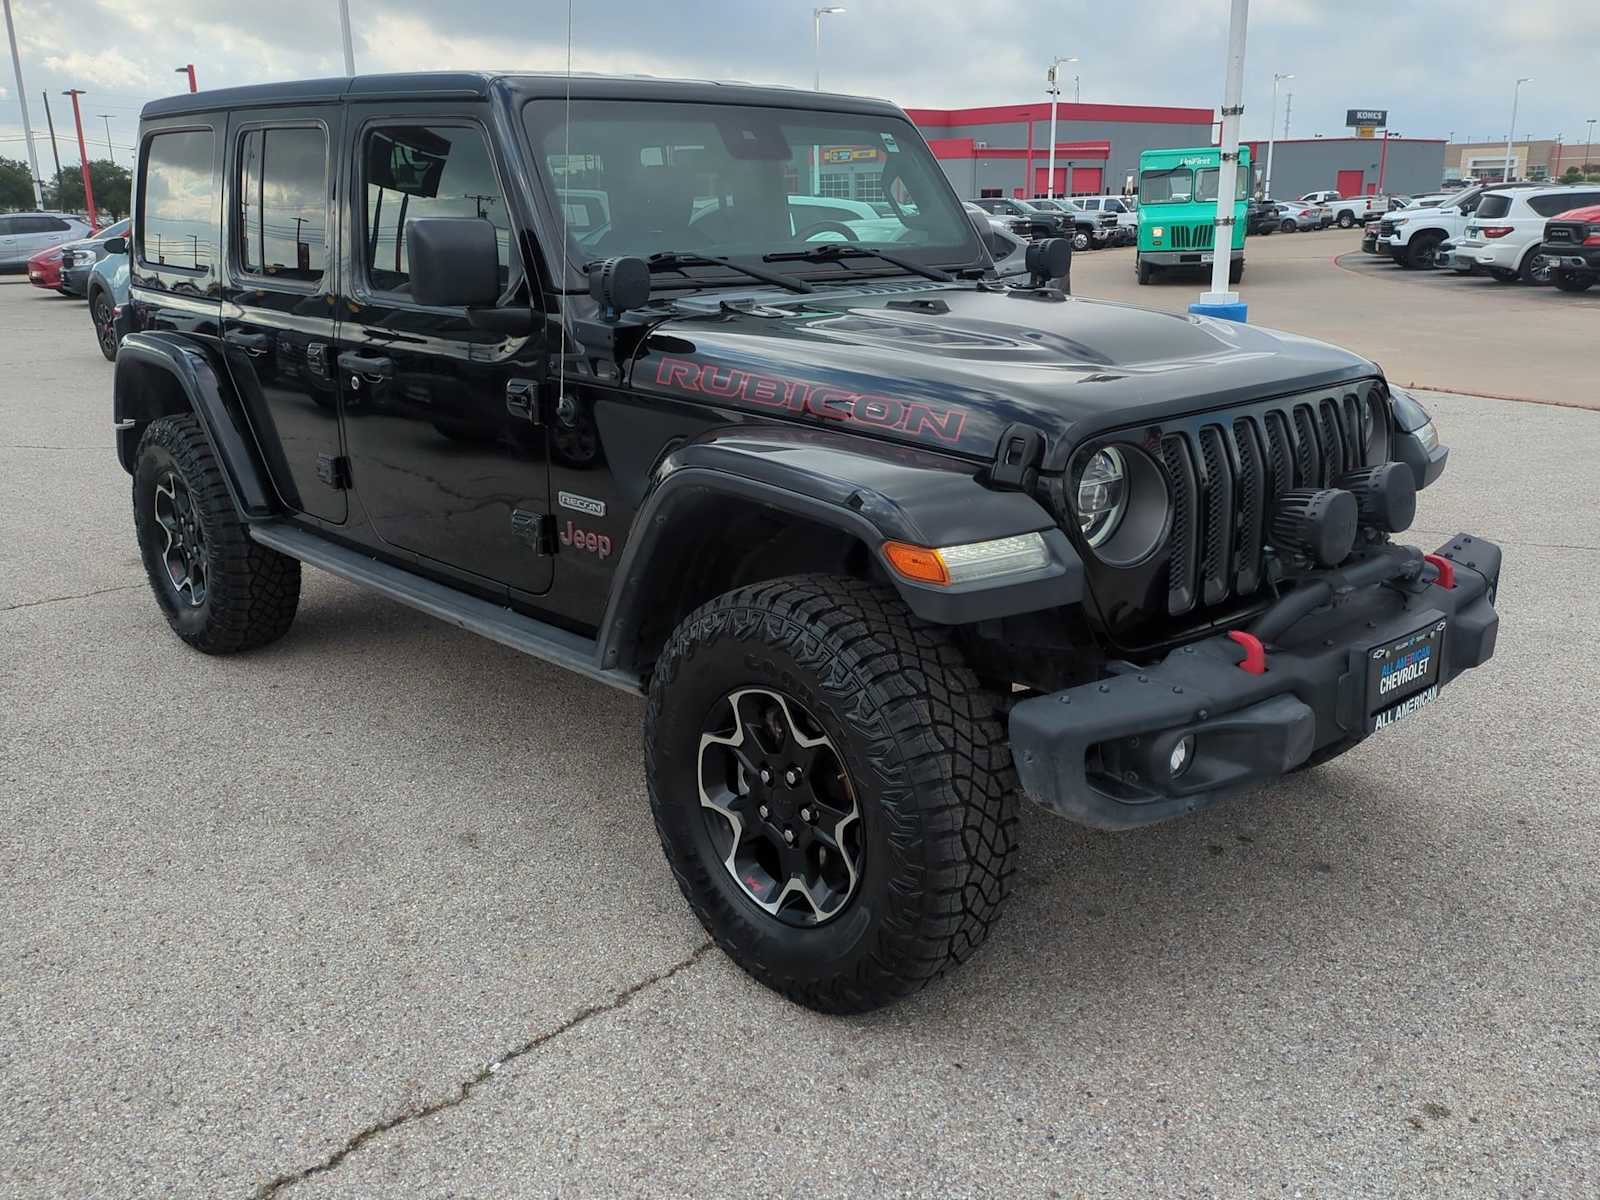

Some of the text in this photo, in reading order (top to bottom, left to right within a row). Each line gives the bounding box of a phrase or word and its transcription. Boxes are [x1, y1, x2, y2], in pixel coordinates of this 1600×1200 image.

[656, 357, 967, 442] RUBICON
[561, 495, 601, 513] RECON
[559, 520, 611, 560] Jeep
[1379, 656, 1430, 695] CHEVROLET
[1381, 645, 1432, 677] ALL AMERICAN
[1374, 684, 1439, 731] ALL AMERICAN
